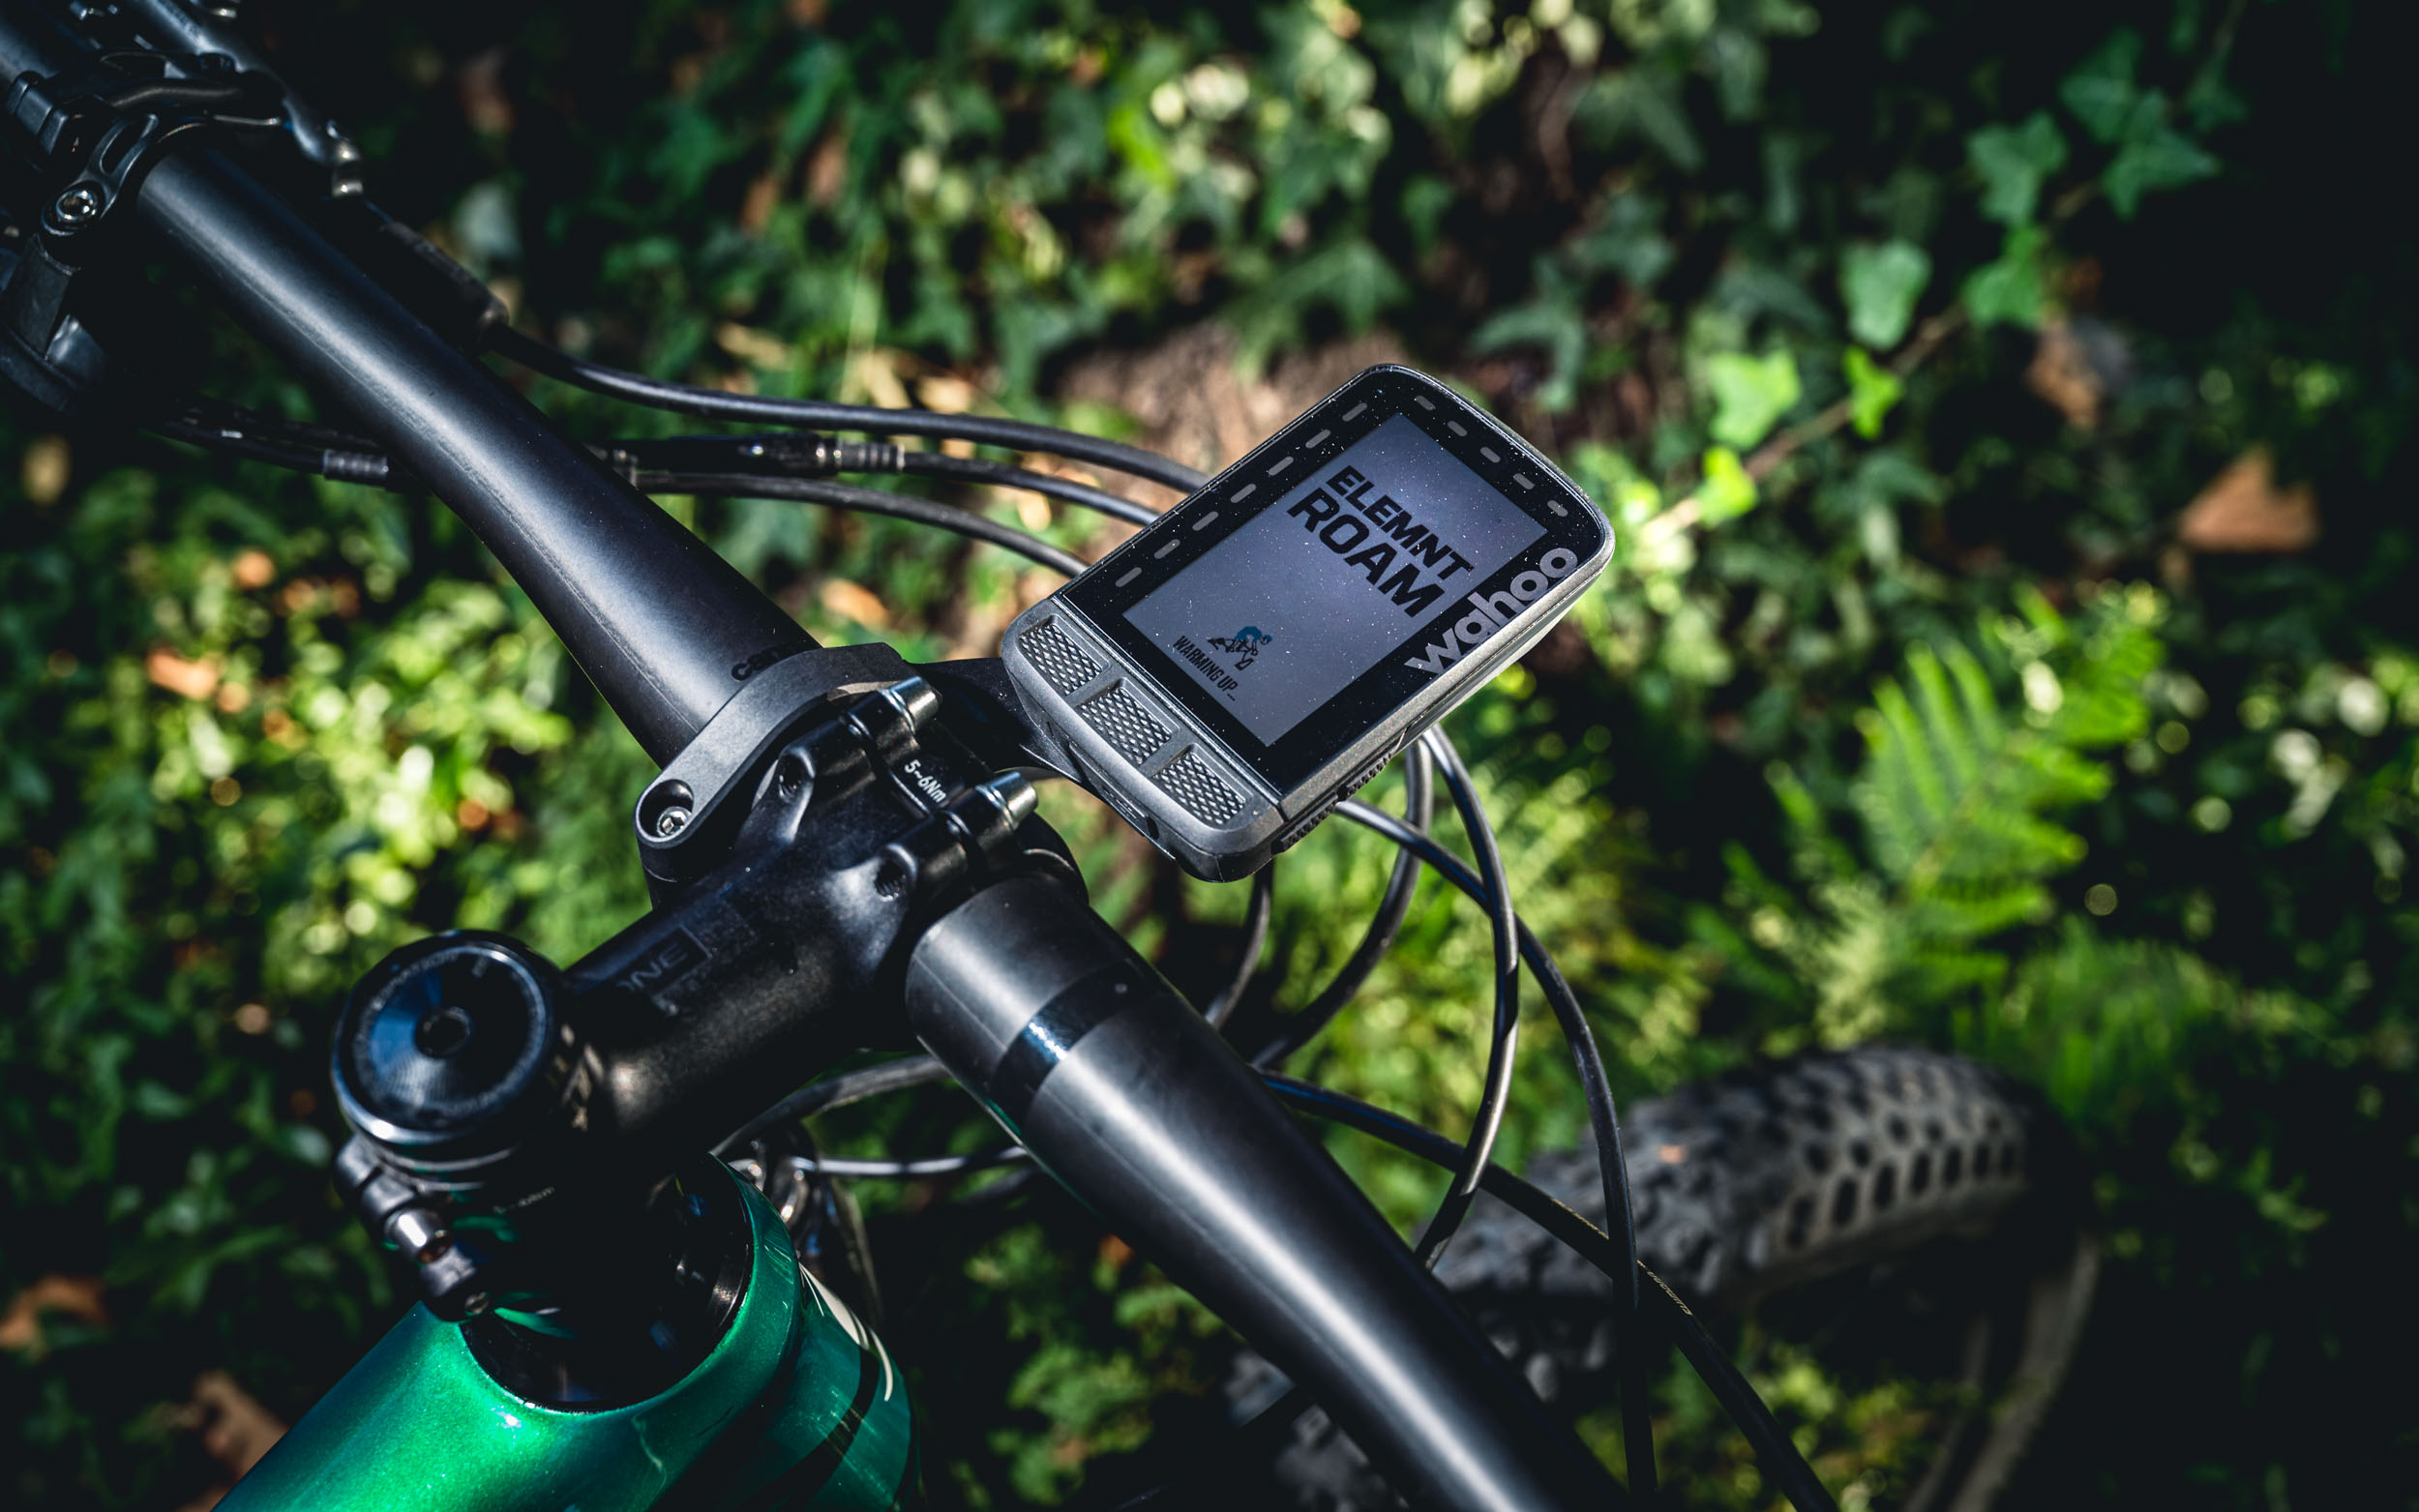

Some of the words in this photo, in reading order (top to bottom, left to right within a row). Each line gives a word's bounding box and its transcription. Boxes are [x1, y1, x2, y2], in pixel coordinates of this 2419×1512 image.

[1287, 488, 1445, 617] ROAM
[1327, 465, 1474, 579] ELEMNT
[1173, 636, 1225, 682] WARMING
[1405, 548, 1578, 674] wahoo
